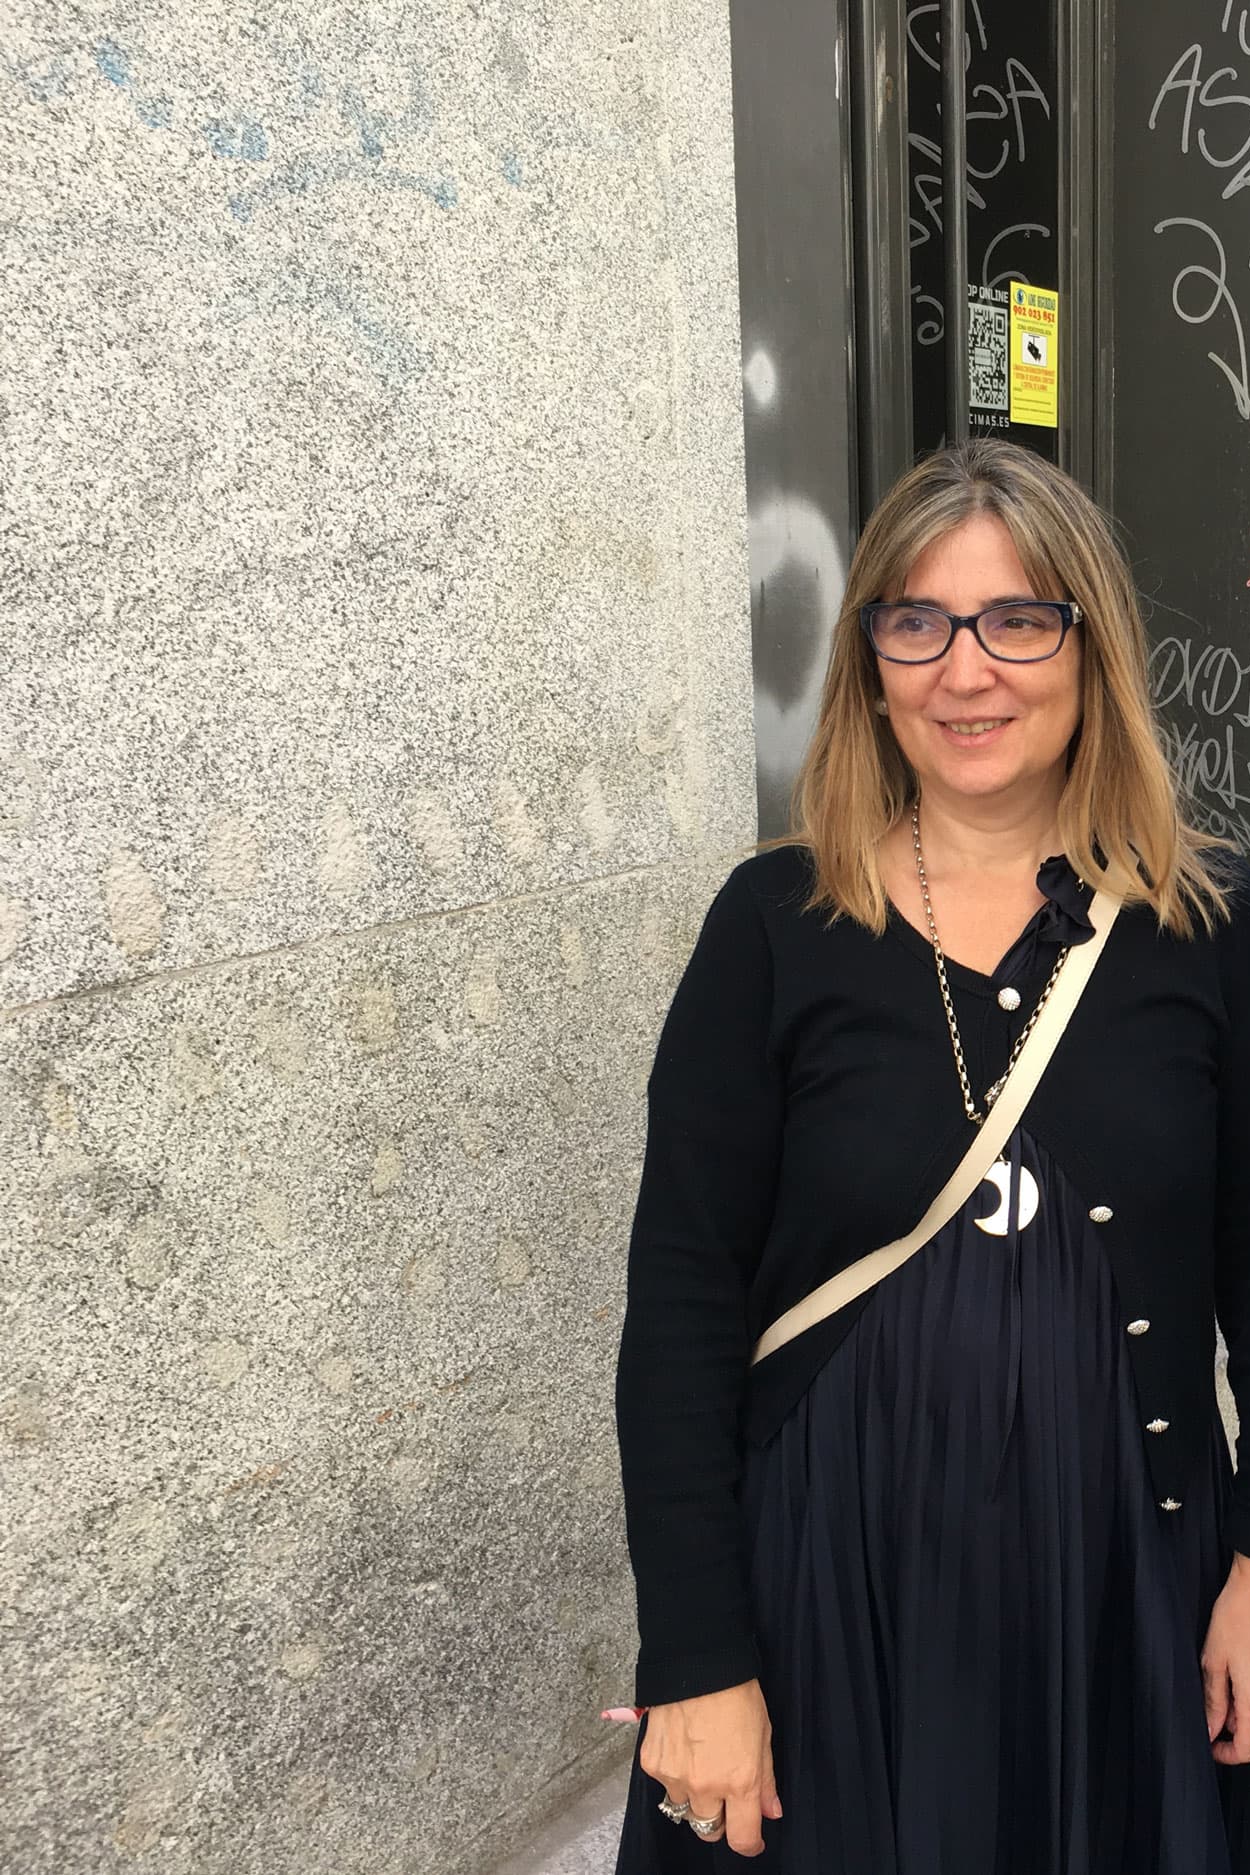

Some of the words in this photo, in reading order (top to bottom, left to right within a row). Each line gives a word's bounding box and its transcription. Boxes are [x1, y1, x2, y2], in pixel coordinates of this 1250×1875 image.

[979, 286, 1009, 304] ONLINE
[1013, 305, 1027, 317] 902
[968, 413, 1010, 428] CIMAS.ES
